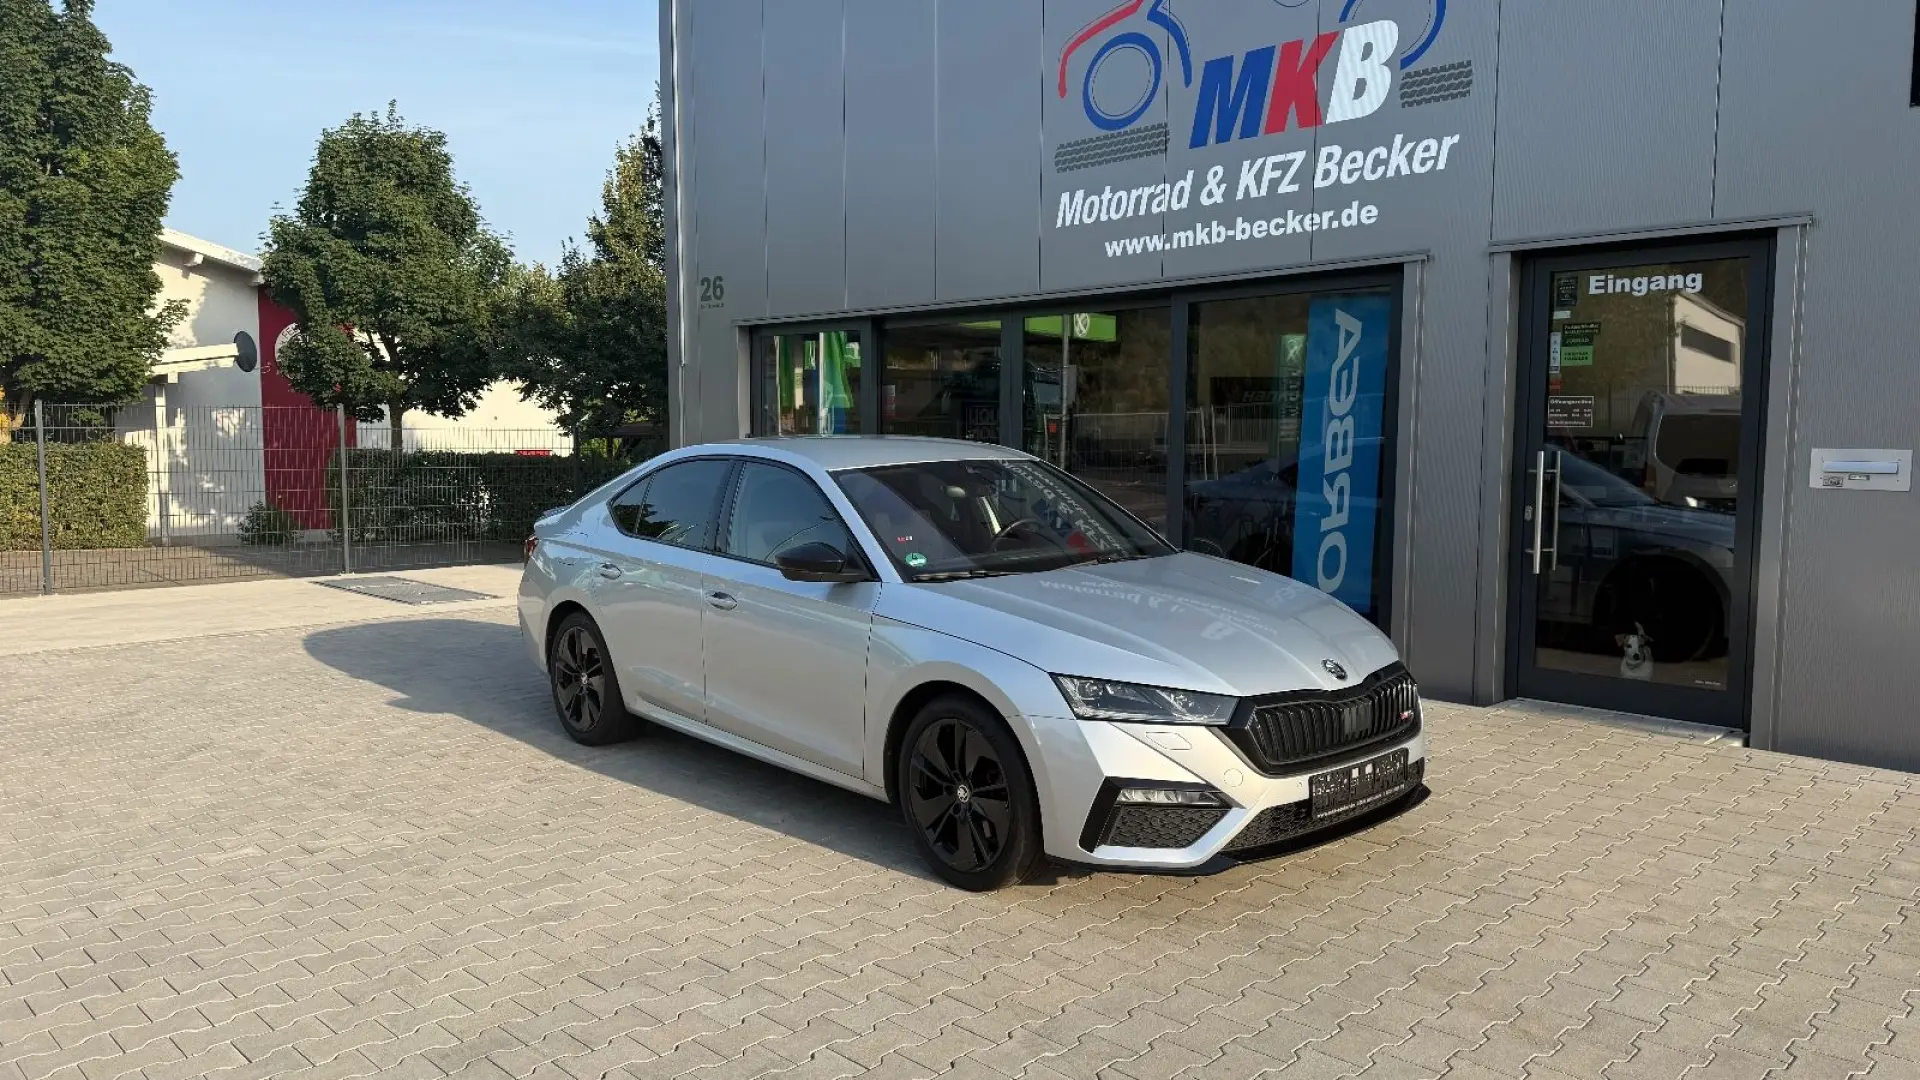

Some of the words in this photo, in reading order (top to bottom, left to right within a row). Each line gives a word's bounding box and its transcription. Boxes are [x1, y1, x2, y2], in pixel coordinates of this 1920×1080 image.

[1189, 19, 1399, 149] MKB
[1056, 169, 1194, 228] Motorrad
[1200, 165, 1226, 206] &
[1236, 150, 1306, 200] KFZ
[1314, 134, 1459, 189] Becker
[1105, 200, 1378, 257] www.mkb-becker.de
[700, 275, 725, 302] 26
[1589, 272, 1703, 296] Eingang
